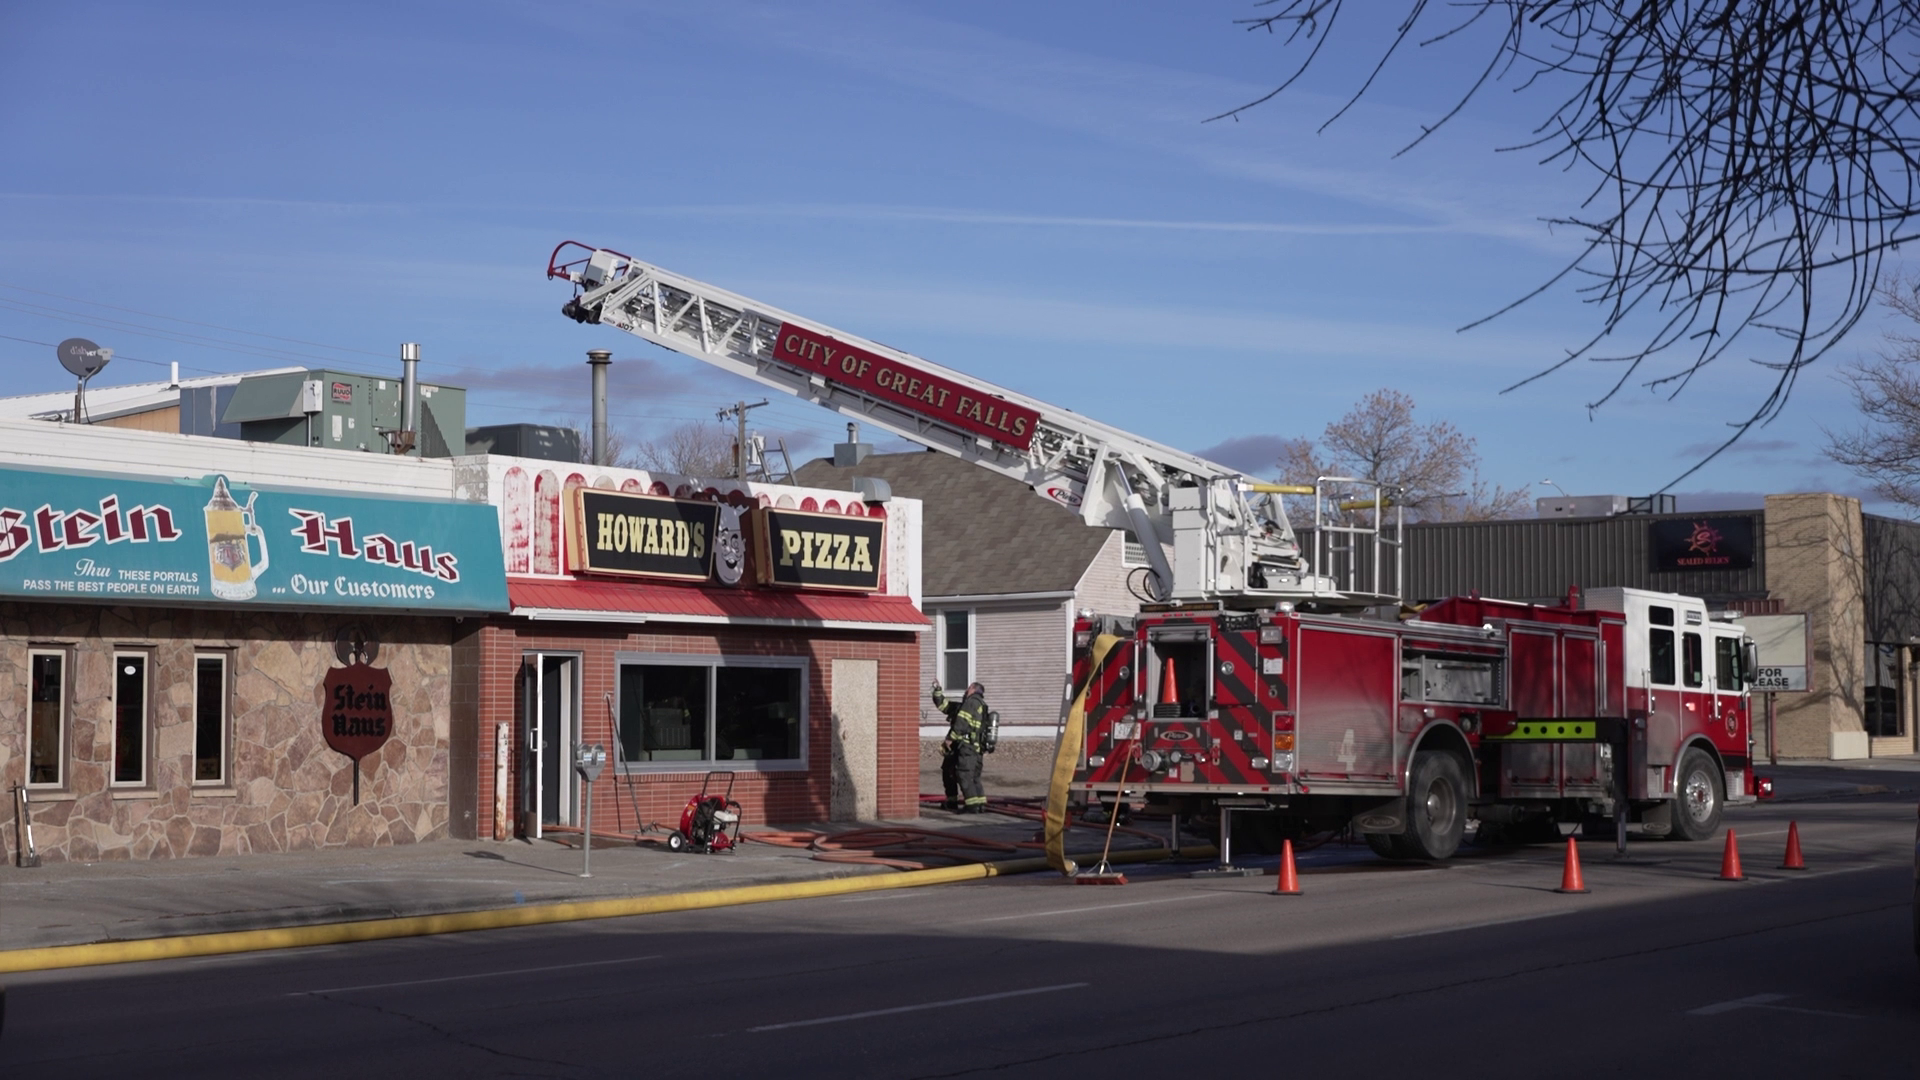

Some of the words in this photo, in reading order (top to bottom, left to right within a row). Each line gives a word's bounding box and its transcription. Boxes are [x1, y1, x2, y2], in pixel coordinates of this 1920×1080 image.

[784, 333, 837, 366] CITY
[841, 354, 871, 379] OF
[875, 367, 951, 409] GREAT
[955, 395, 1027, 437] FALLS
[288, 507, 460, 584] Haus
[597, 513, 705, 558] HOWARD'S
[780, 530, 873, 572] PIZZA
[74, 558, 112, 577] Thru
[118, 570, 151, 581] THESE
[153, 571, 198, 582] PORTALS
[23, 579, 51, 590] PASS
[54, 580, 75, 591] THE
[77, 581, 104, 592] BEST
[107, 582, 147, 594] PEOPLE
[150, 583, 164, 594] ON
[167, 584, 200, 595] EARTH
[291, 573, 329, 595] Our
[334, 576, 435, 600] Customers
[1758, 668, 1782, 677] FOR
[333, 684, 387, 711] Stein
[1337, 728, 1357, 771] 4
